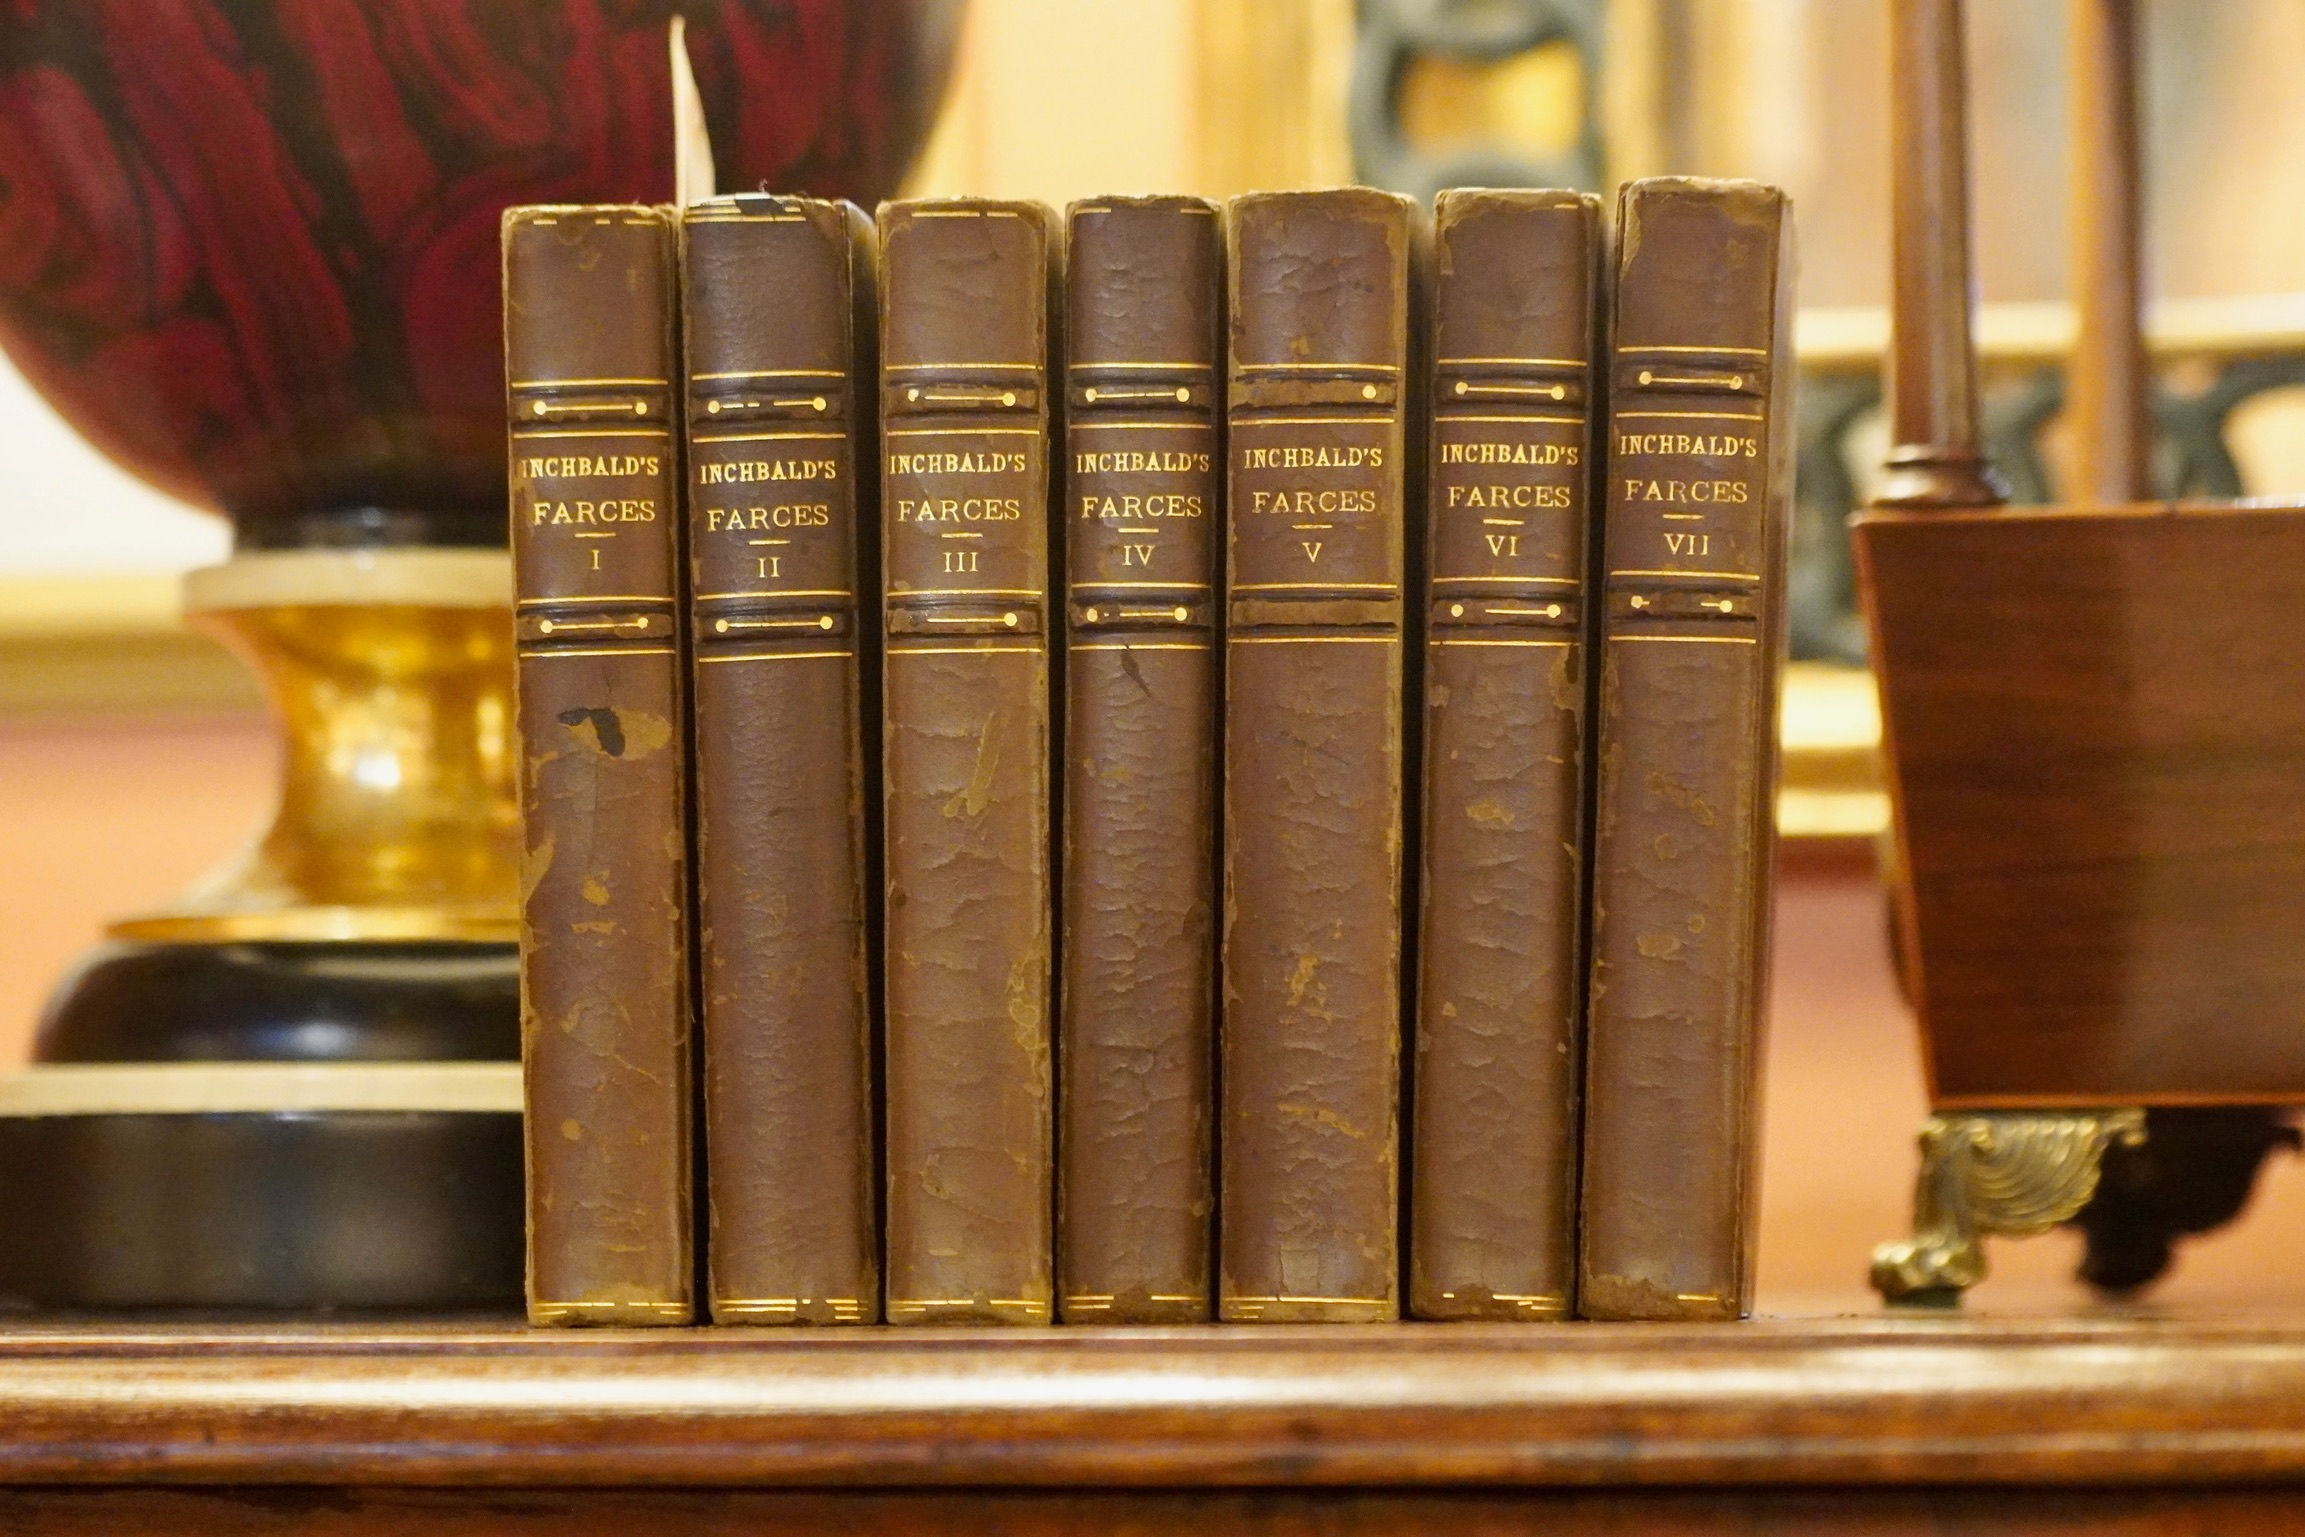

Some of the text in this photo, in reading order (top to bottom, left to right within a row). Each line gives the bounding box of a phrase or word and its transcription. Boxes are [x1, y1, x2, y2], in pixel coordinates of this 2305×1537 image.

[1244, 447, 1383, 469] INCHBALD'S
[1441, 444, 1579, 468] INCHBALD'S
[1620, 435, 1757, 459] INCHBALD'S
[521, 455, 660, 479] INCHBALD'S
[700, 460, 836, 485] INCHBALD'S
[890, 453, 1026, 475] INCHBALD'S
[1076, 451, 1210, 475] INCHBALD'S
[1252, 490, 1376, 515] FARCES
[1447, 485, 1571, 509] FARCES
[1625, 479, 1747, 504] FARCES
[533, 499, 656, 525] FARCES
[707, 504, 829, 532] FARCES
[898, 499, 1021, 523] FARCES
[1081, 495, 1202, 519] FARCES
[1121, 544, 1155, 566] IV
[1302, 542, 1321, 564] V
[1485, 535, 1518, 557] VI
[1664, 533, 1709, 556] VII
[591, 549, 600, 570] I
[758, 556, 781, 578] II
[943, 551, 978, 573] III
